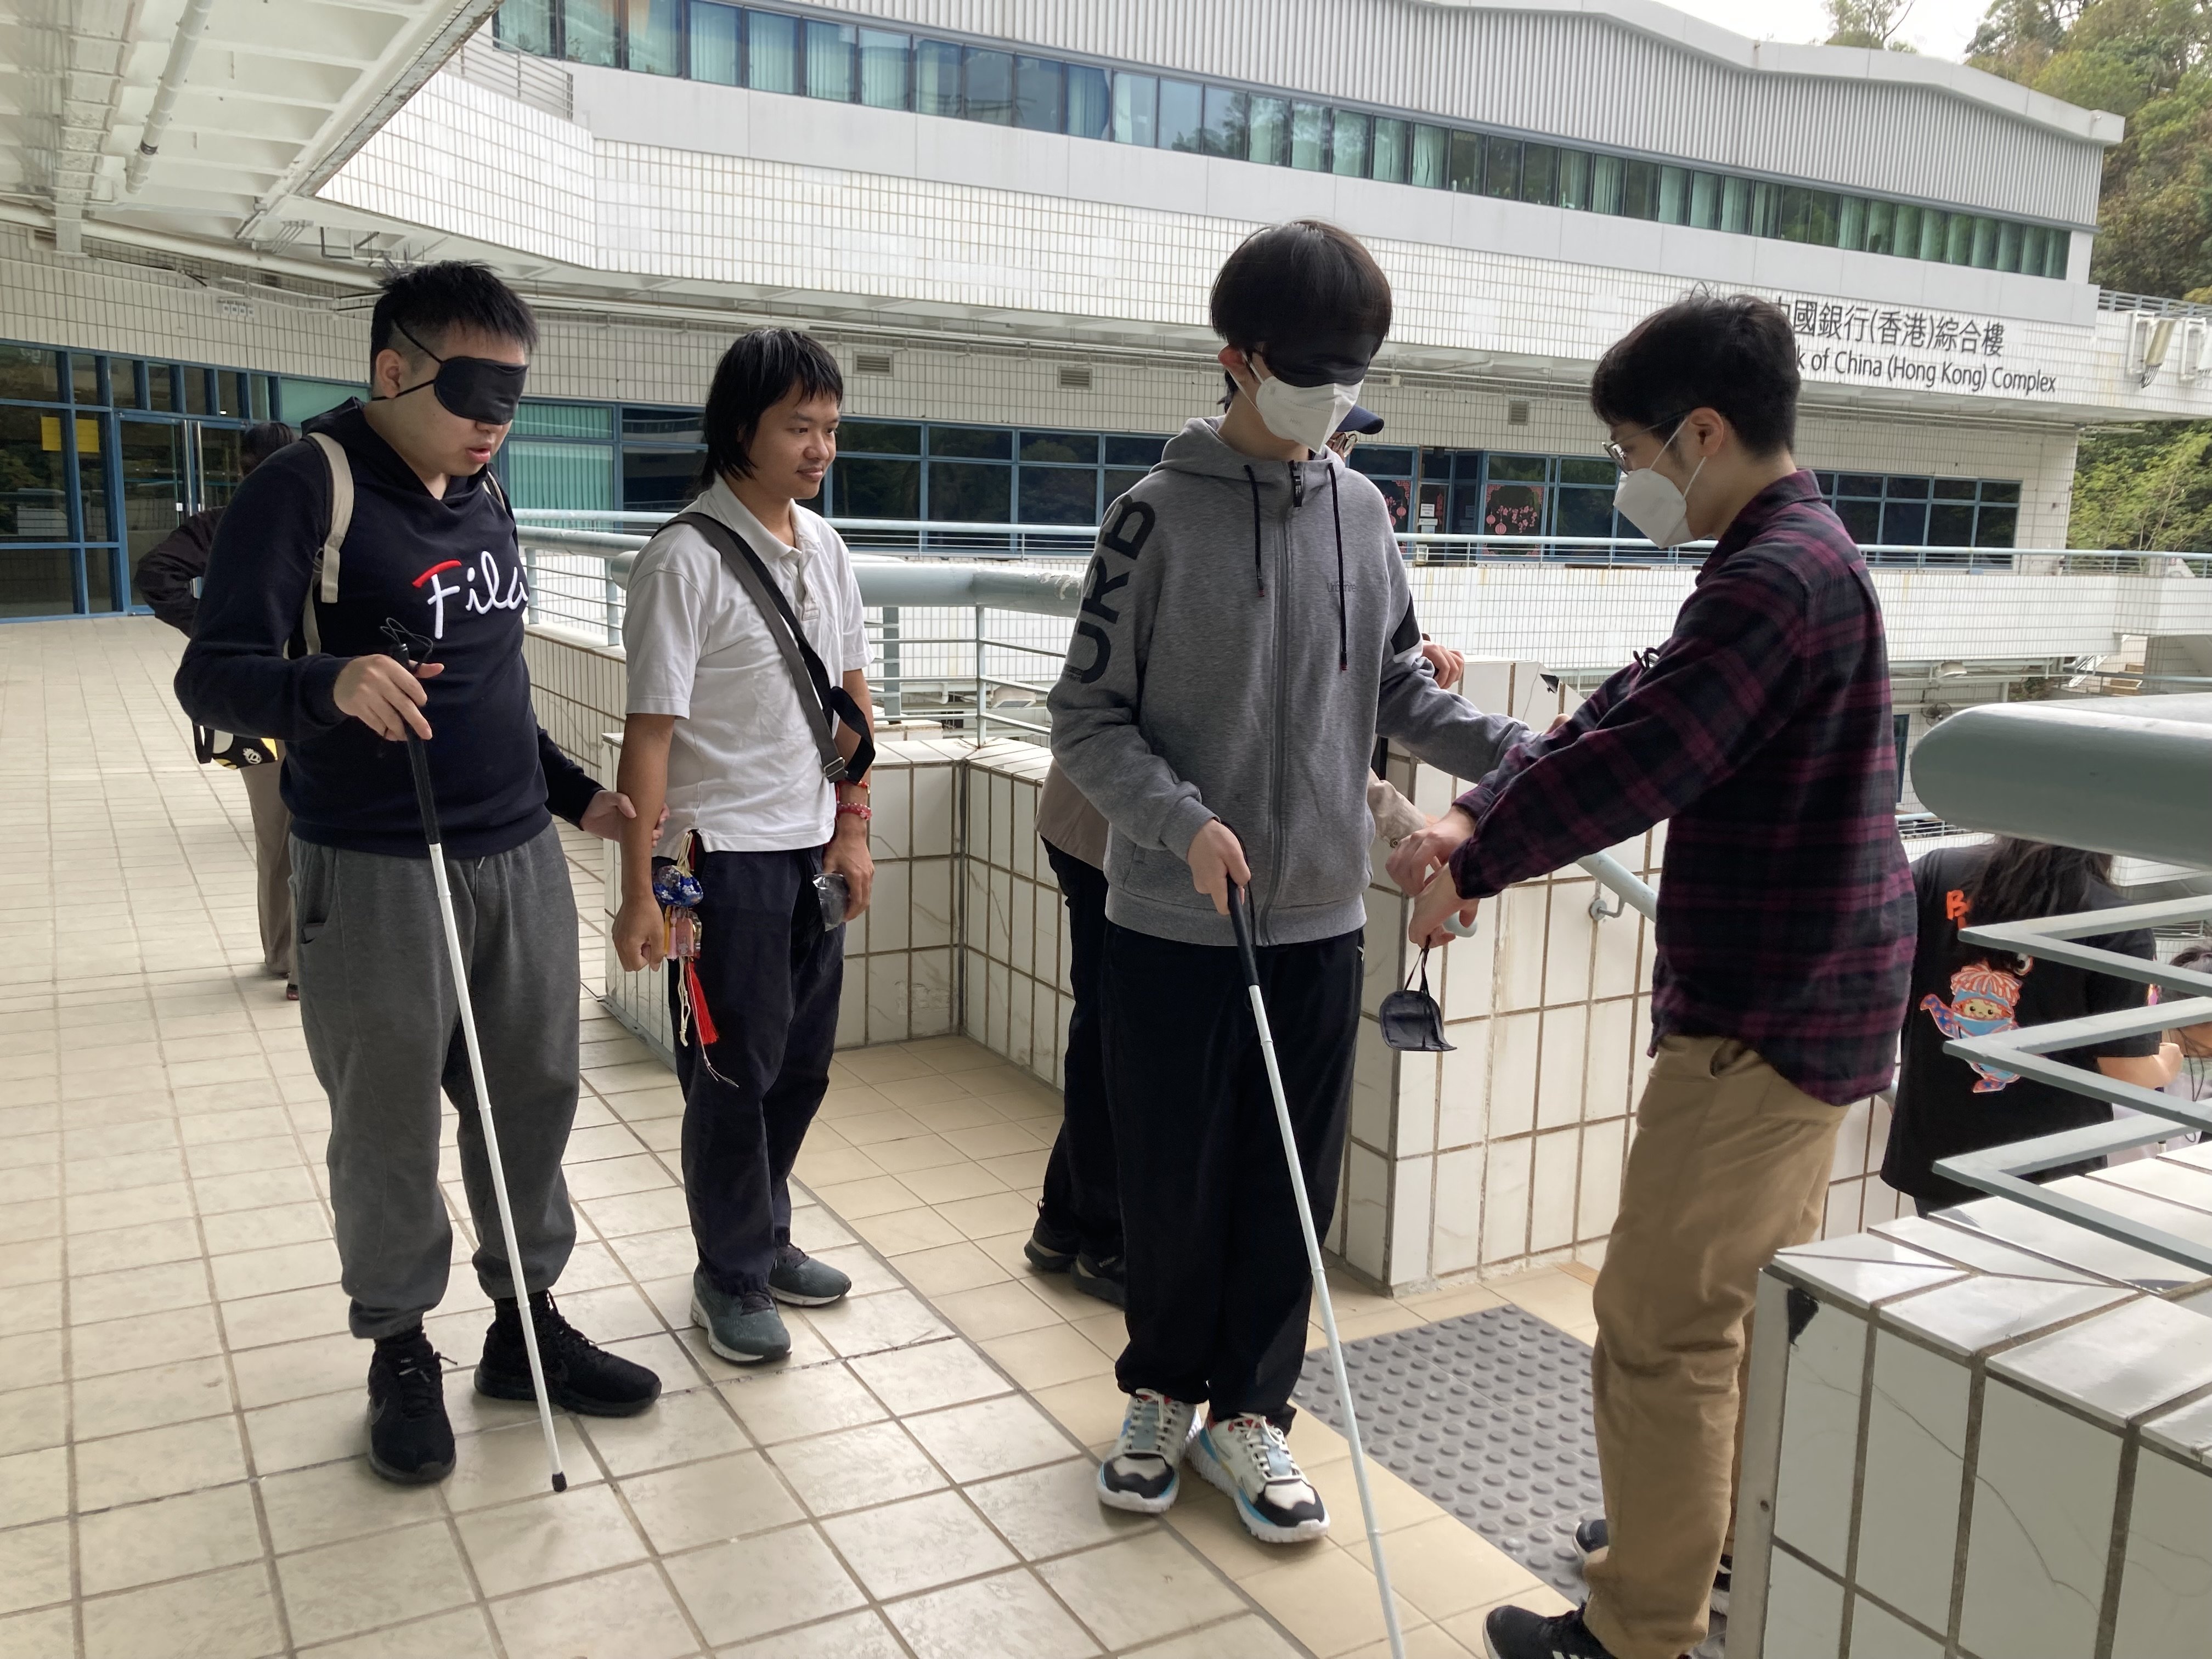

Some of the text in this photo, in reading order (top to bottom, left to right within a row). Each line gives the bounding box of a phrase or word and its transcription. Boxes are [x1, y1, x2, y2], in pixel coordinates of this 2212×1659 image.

[1811, 347, 1830, 371] of
[1835, 349, 1882, 377] China
[1887, 354, 1936, 387] (Hong
[1941, 360, 1987, 392] Kong)
[1992, 366, 2056, 396] Complex
[412, 550, 528, 639] Fila
